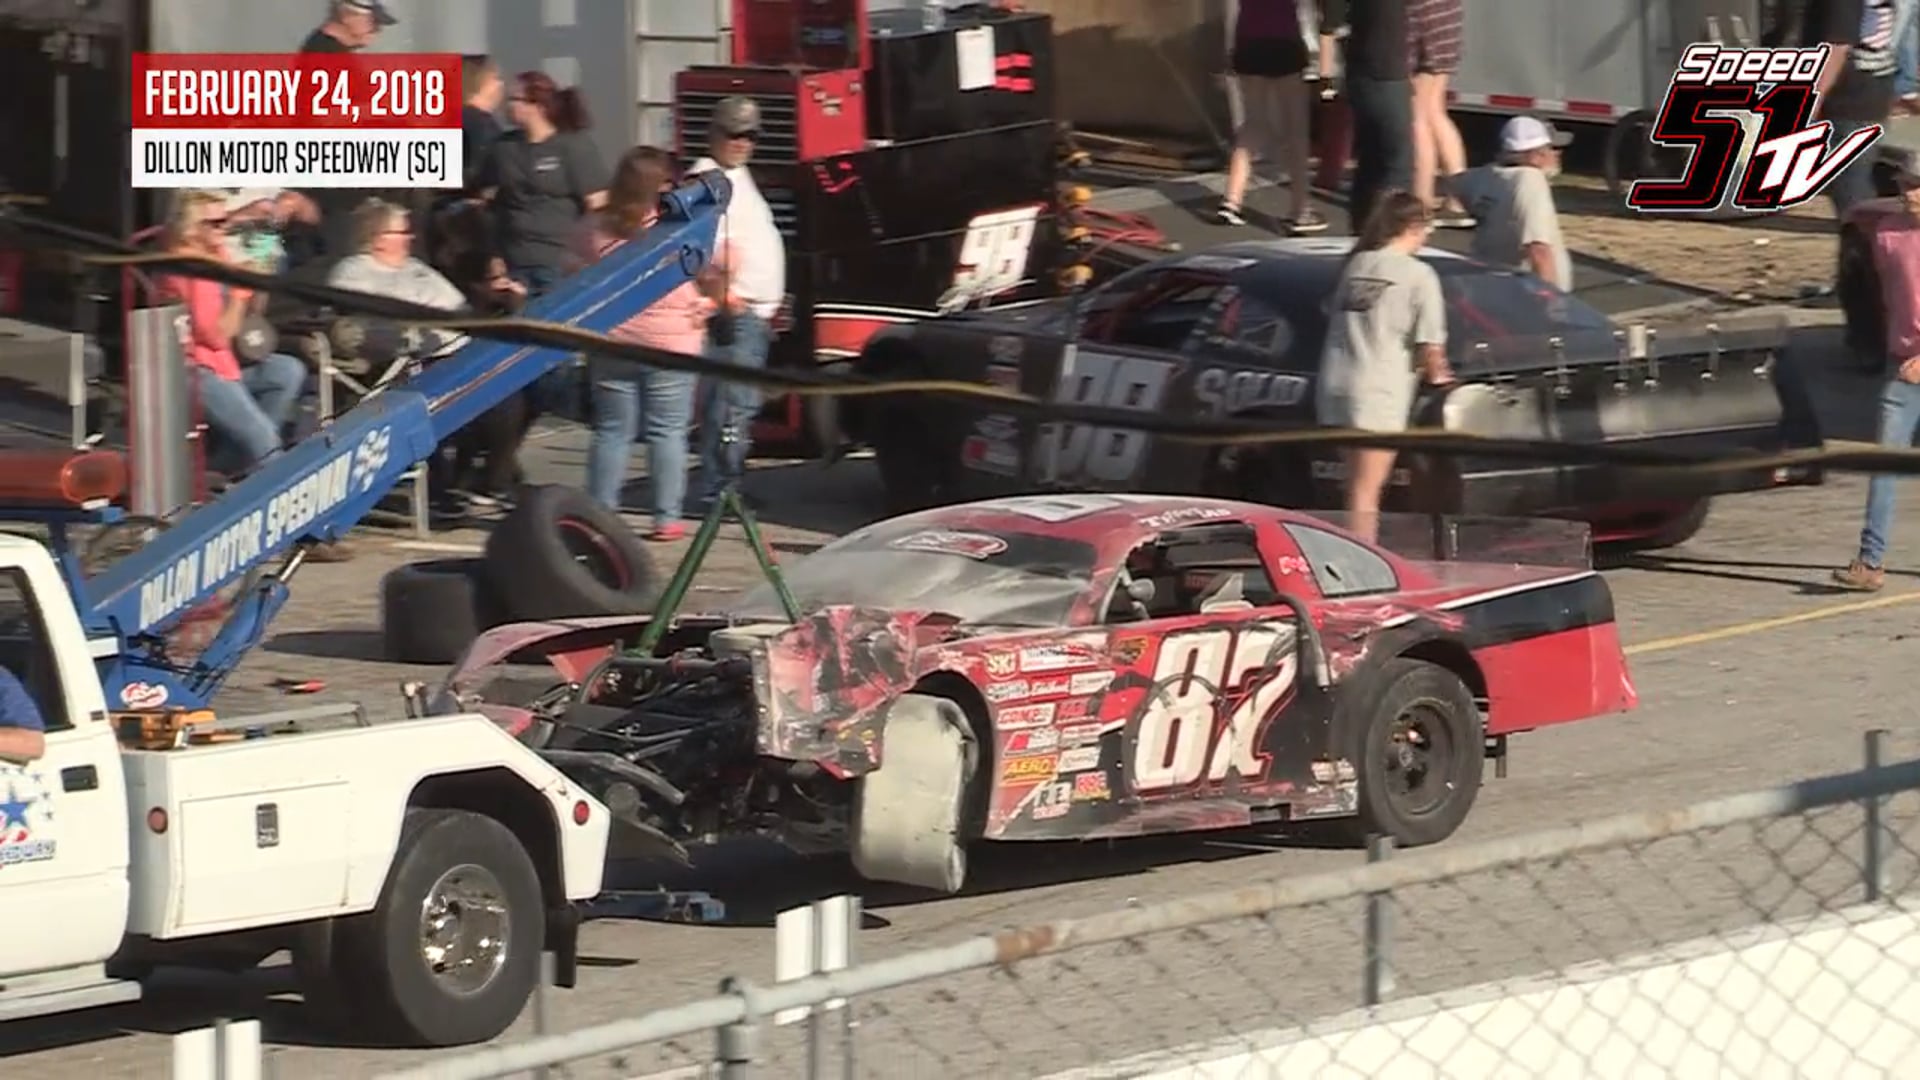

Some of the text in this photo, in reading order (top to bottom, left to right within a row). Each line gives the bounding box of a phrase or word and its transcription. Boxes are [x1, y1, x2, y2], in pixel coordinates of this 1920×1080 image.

[139, 450, 353, 630] DILLON MOTOR SPEEDWAY
[1003, 758, 1052, 777] AERO
[1134, 621, 1298, 790] 87
